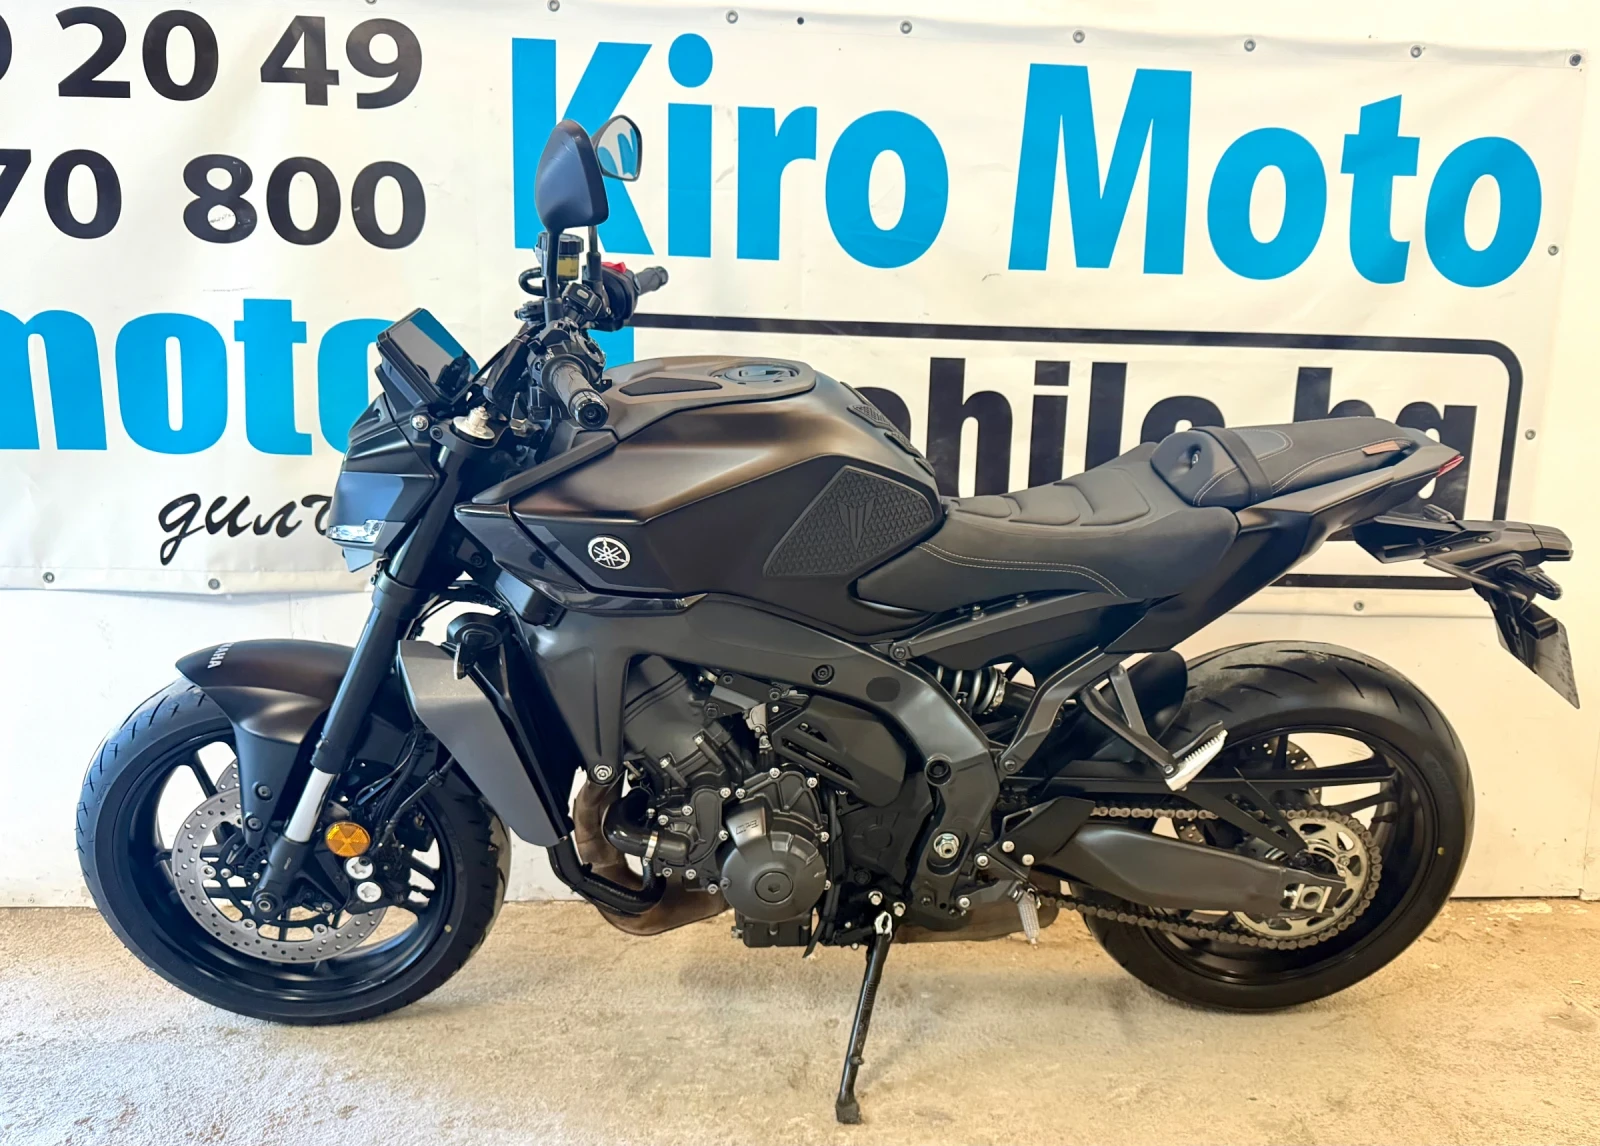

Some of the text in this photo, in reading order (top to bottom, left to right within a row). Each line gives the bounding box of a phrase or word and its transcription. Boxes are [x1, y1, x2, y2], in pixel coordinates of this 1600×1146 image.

[55, 6, 219, 102] 20
[260, 15, 423, 109] 49
[183, 154, 426, 250] 800
[512, 33, 1542, 287] Kiro Moto
